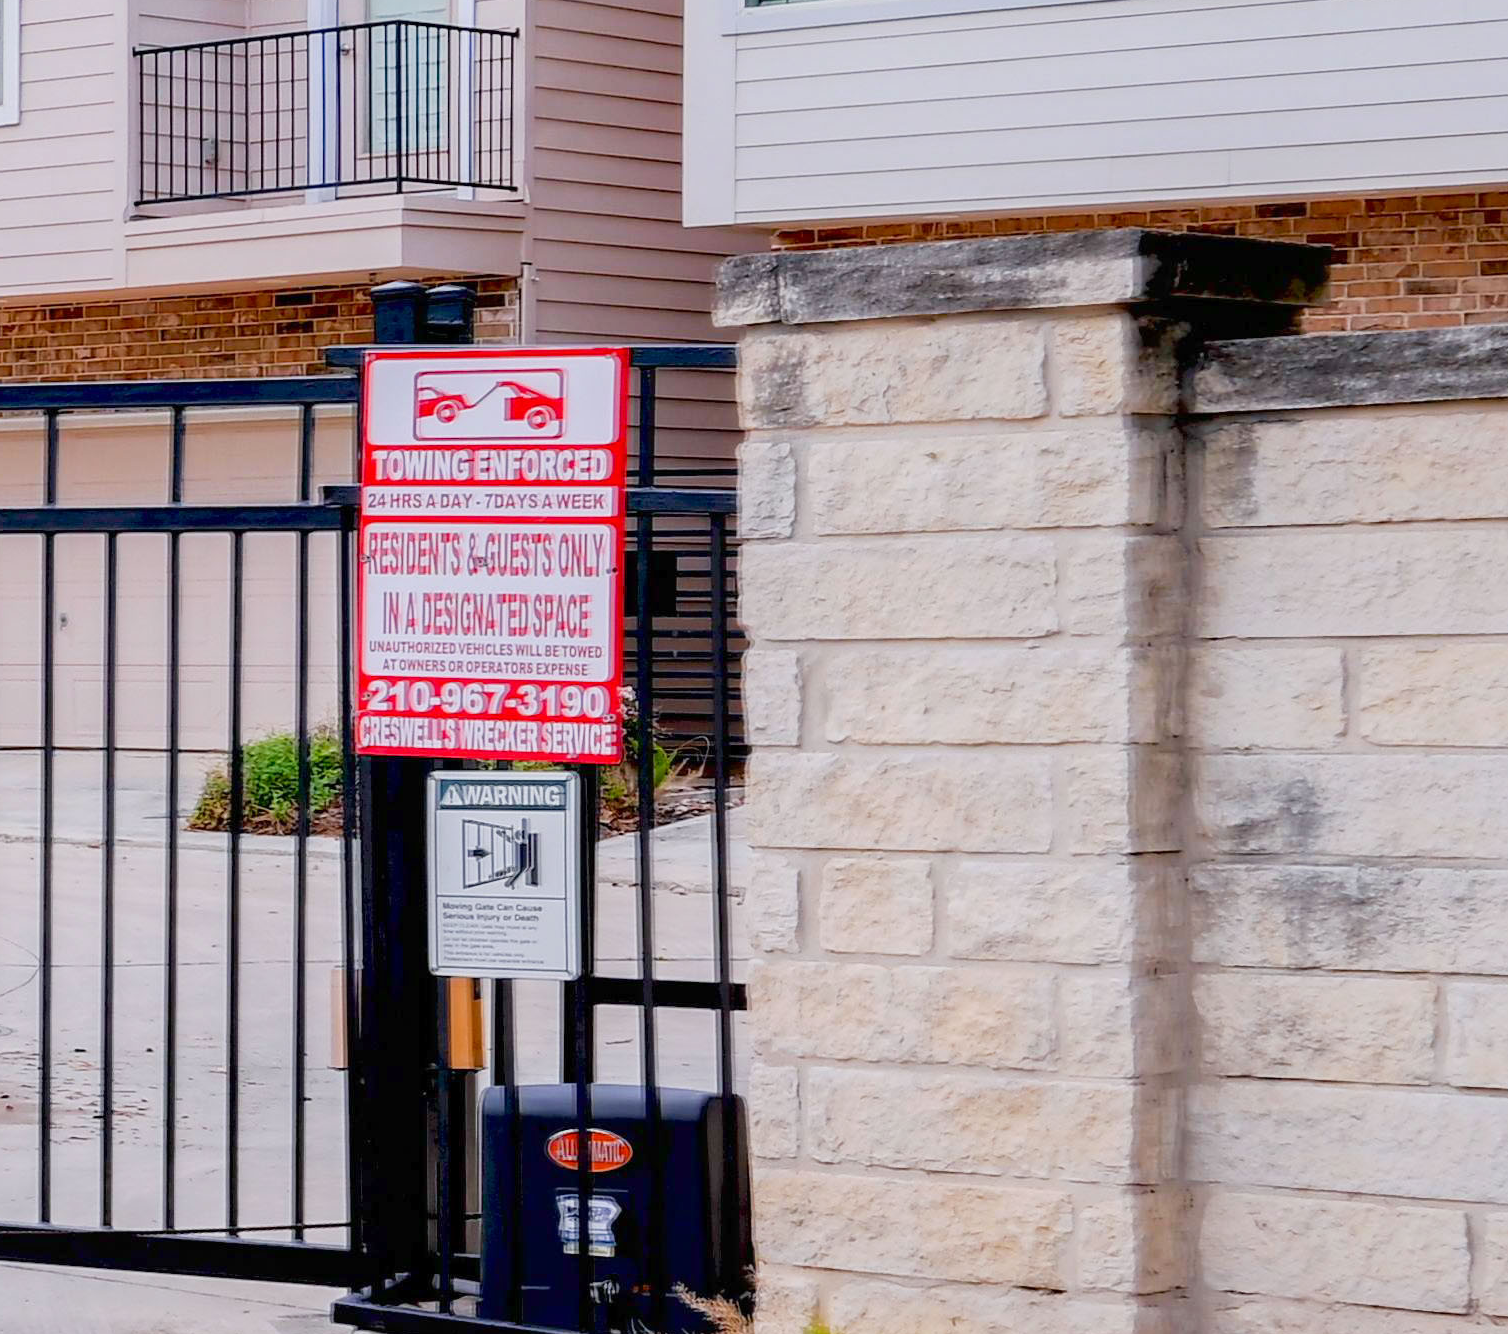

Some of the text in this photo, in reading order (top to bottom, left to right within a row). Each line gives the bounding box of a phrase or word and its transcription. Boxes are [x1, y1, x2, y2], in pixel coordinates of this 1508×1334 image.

[371, 449, 610, 482] TOWING ENFORCED
[368, 493, 386, 509] 24
[390, 493, 422, 509] HRS
[425, 493, 436, 509] A
[441, 494, 473, 509] DAY
[541, 494, 553, 510] A
[556, 494, 605, 510] WEEK
[368, 532, 605, 577] RESIDENTS & GUESTS ONLY
[383, 592, 592, 639] IN A DESIGNATED SPACE
[369, 641, 603, 659] UNAUTHORIZED VEHICLES WILL BE TOWED
[383, 659, 588, 676] AT OWNERS OR OPERATORS EXPENSE
[366, 680, 609, 719] 210-967-3190
[360, 716, 618, 756] CRESWELL'S WRECKER SERVICE
[462, 784, 564, 806] WARNING
[442, 902, 542, 913] Moving Gate Can Cause
[442, 912, 539, 922] Serious Injury or Death
